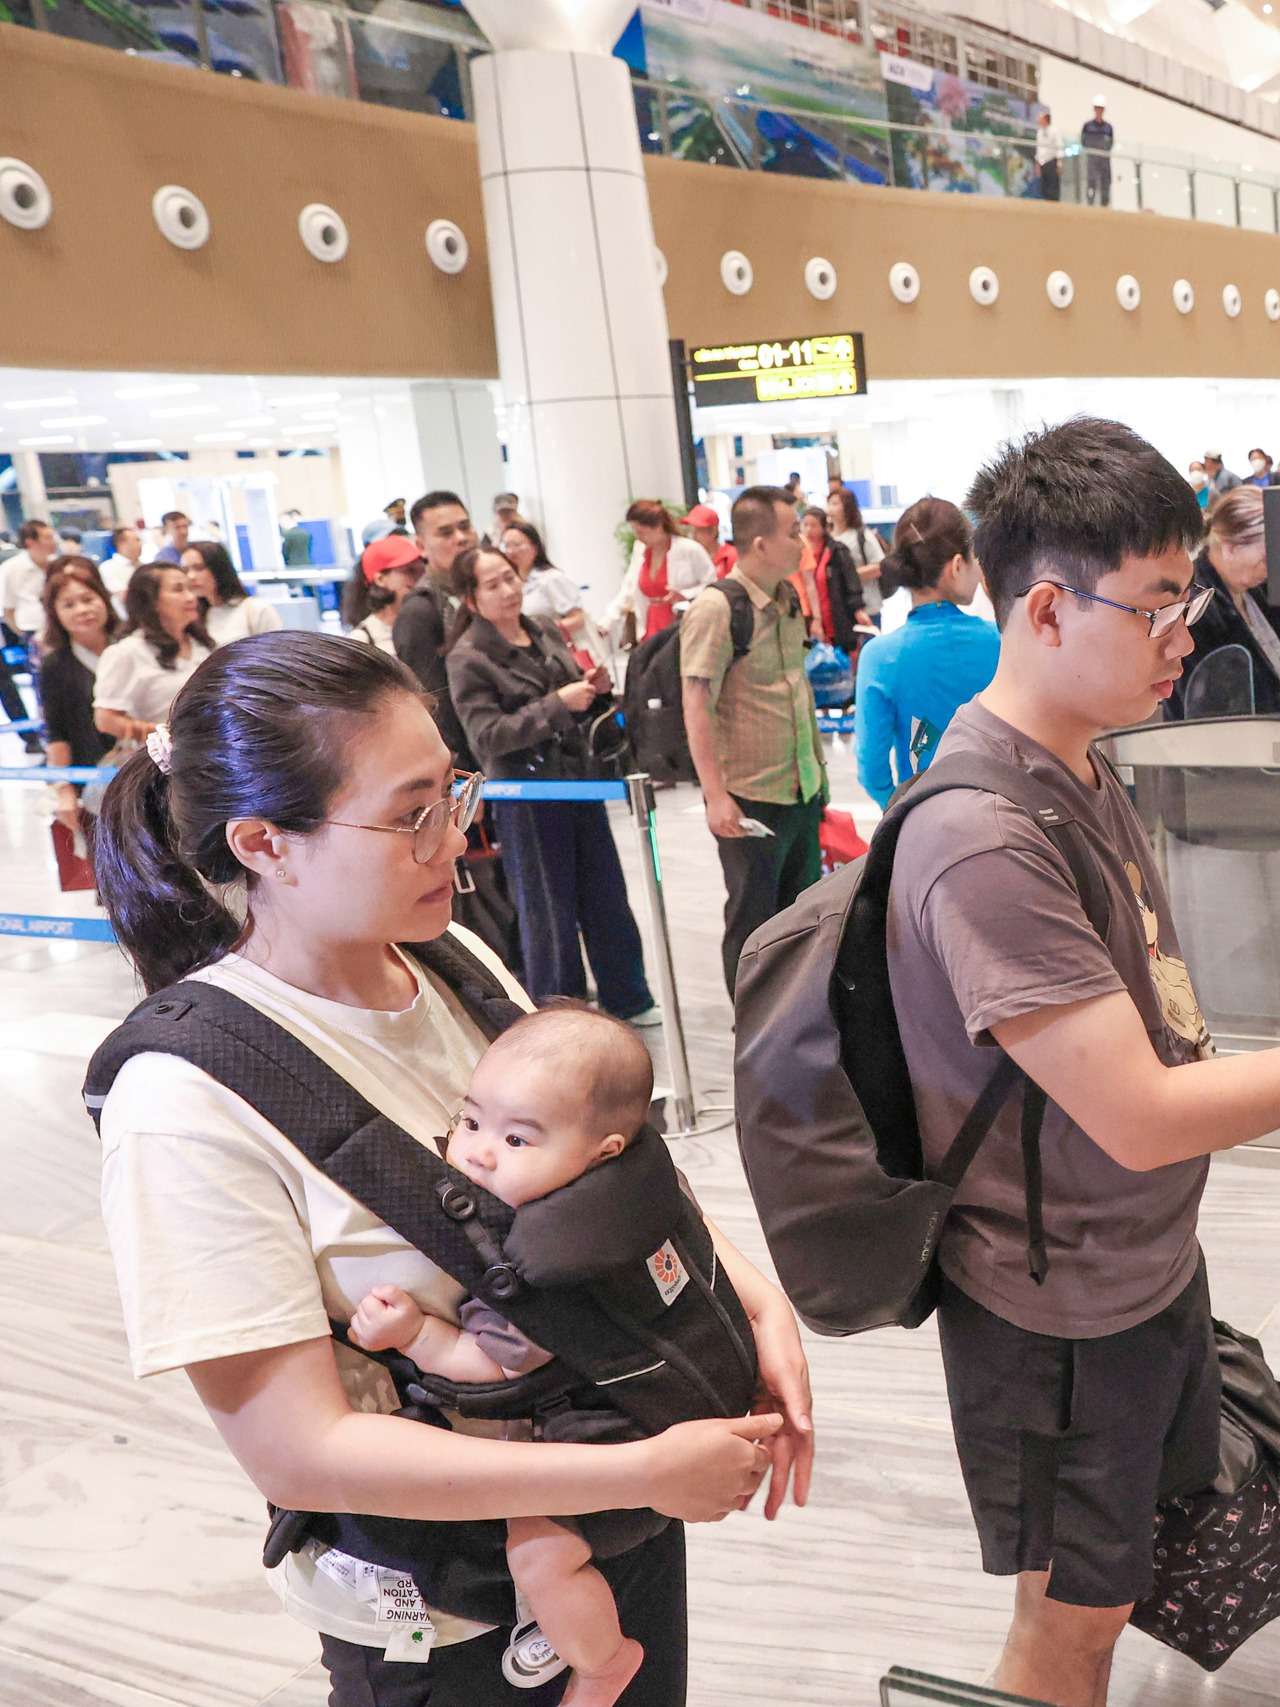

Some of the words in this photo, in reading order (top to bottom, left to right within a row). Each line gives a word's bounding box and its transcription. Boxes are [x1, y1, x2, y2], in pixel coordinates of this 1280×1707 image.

[758, 340, 812, 368] 01-11
[397, 1580, 412, 1588] RD
[394, 1598, 416, 1608] AND
